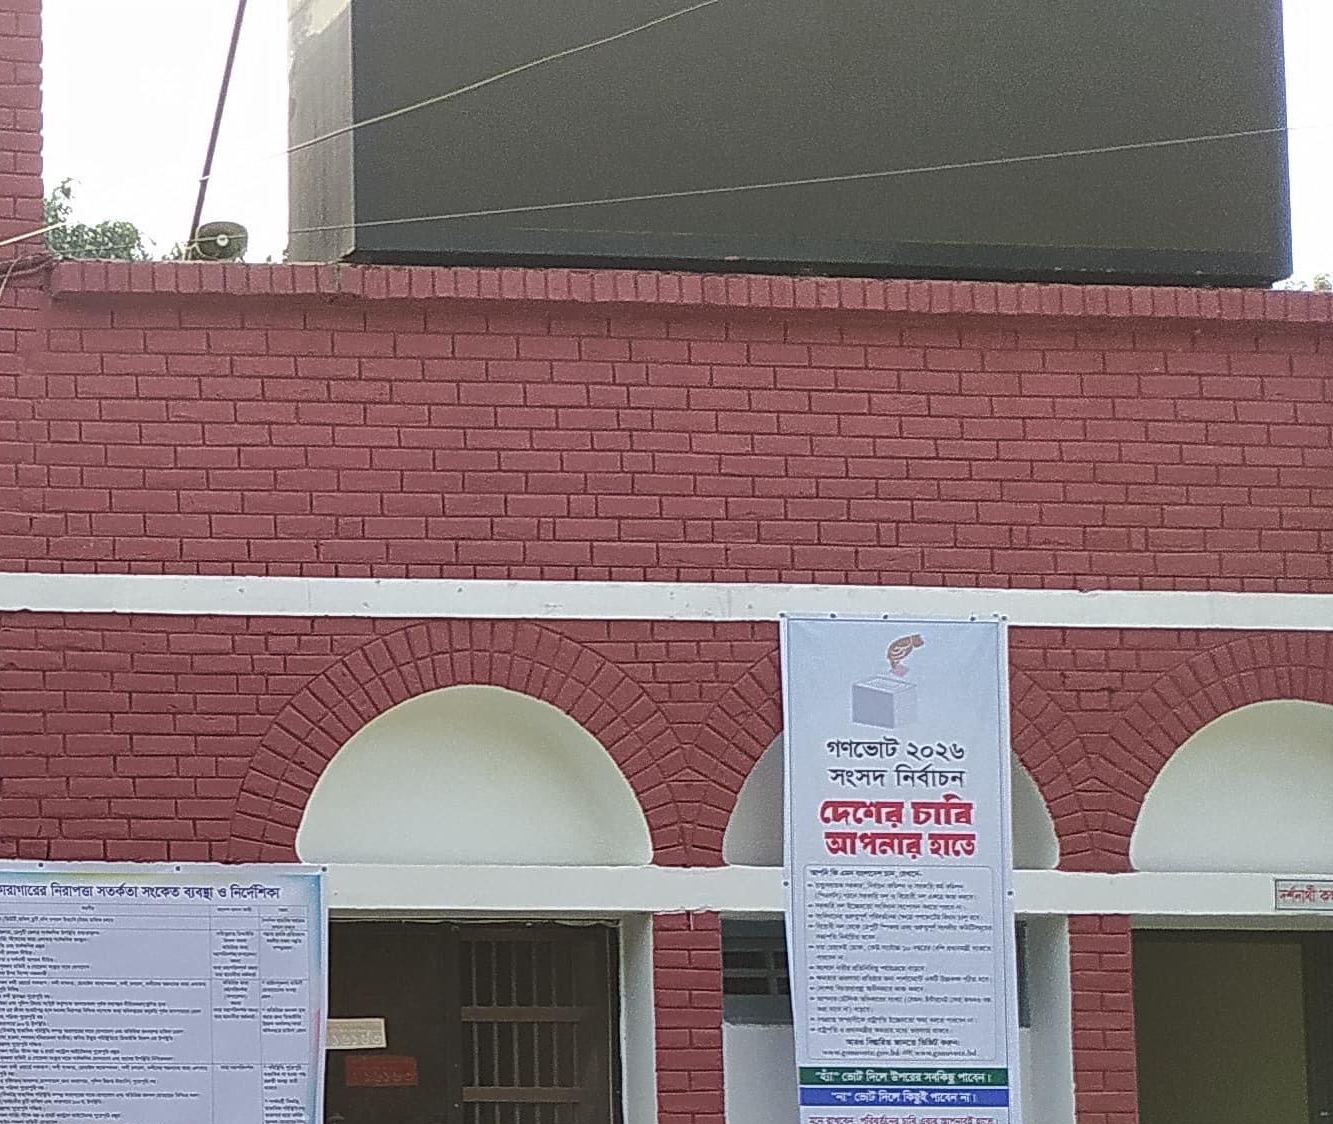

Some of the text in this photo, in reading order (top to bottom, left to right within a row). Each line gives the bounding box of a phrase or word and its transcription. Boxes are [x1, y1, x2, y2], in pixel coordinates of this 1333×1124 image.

[827, 736, 965, 761] গণভোট ২০২৬
[828, 763, 966, 788] সংসদ নির্বাচন
[820, 793, 974, 828] দেশের চাবি
[824, 832, 976, 859] আপনার হাতে
[50, 882, 94, 897] নিরাপত্তা
[97, 883, 137, 898] সতর্কতা
[141, 886, 181, 898] সংকেত
[183, 886, 214, 900] ব্যবস্থা
[217, 887, 227, 898] ও
[229, 884, 280, 899] নির্দেশিকা
[841, 1069, 864, 1082] ভোট
[866, 1070, 888, 1082] দিলে
[854, 1089, 875, 1103] ভোট
[878, 1090, 900, 1103] দিলে
